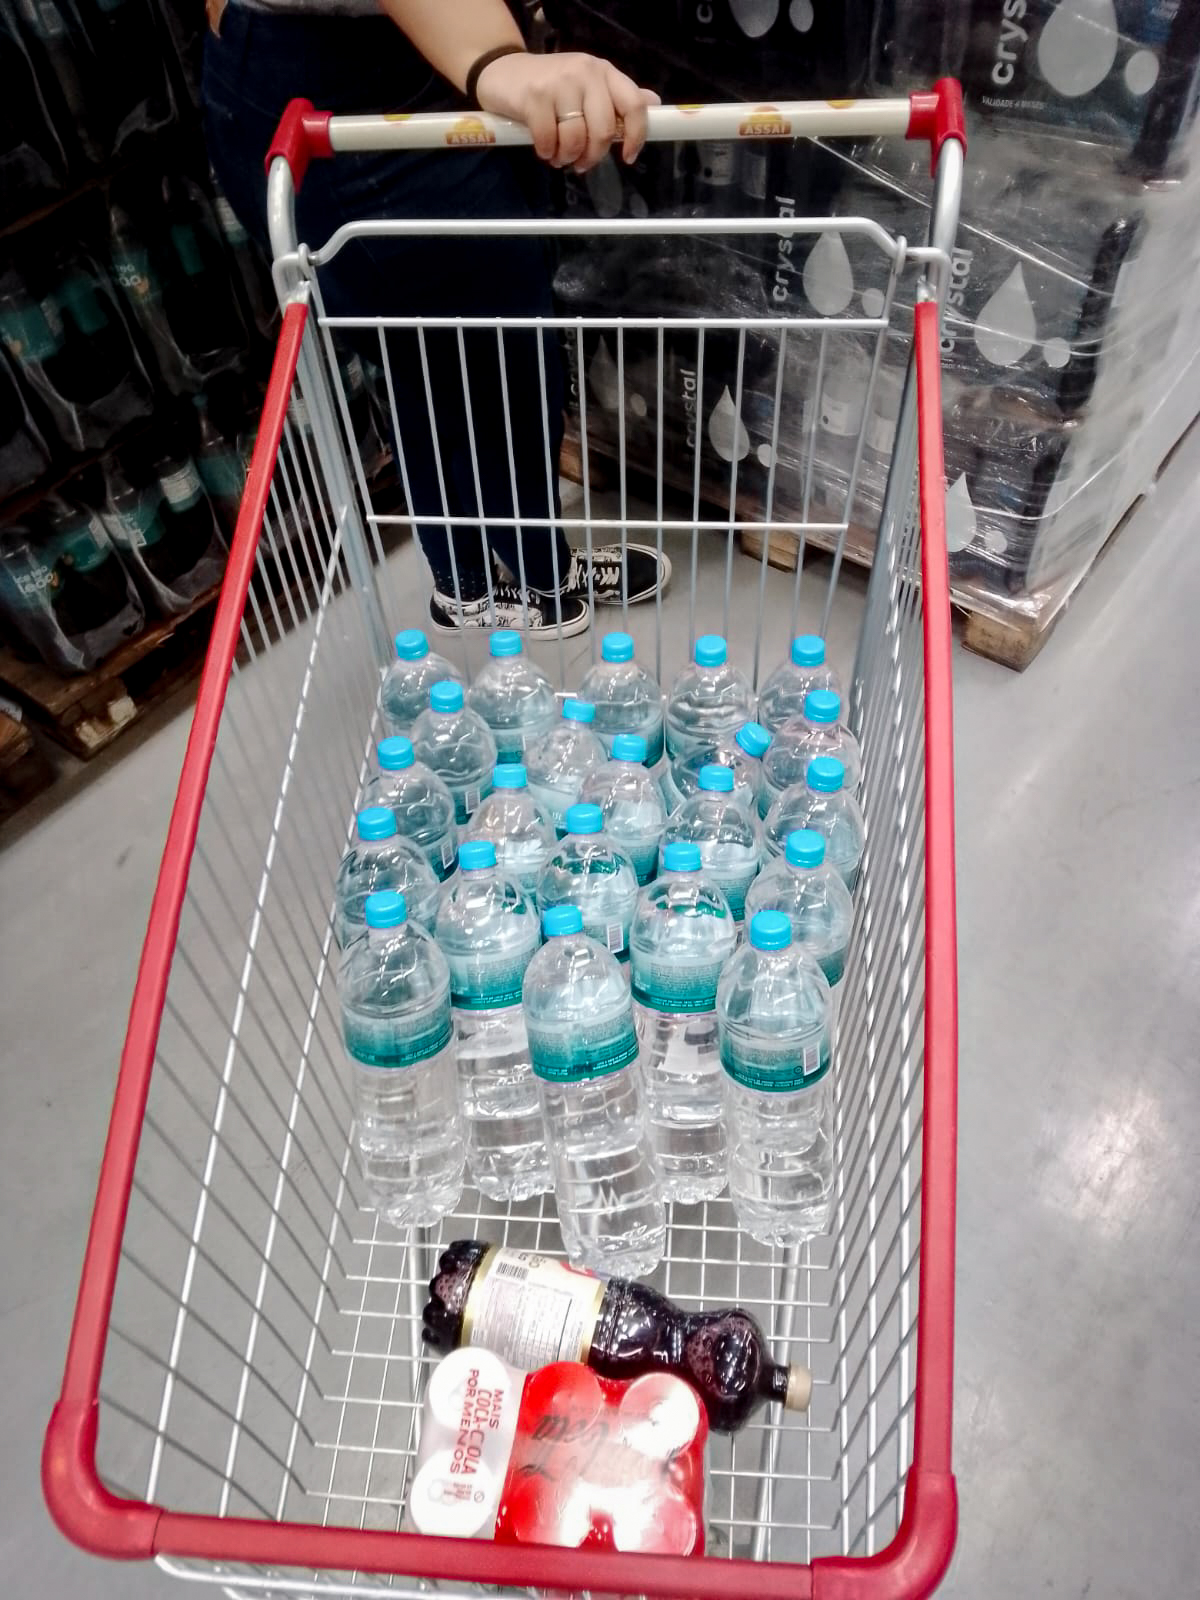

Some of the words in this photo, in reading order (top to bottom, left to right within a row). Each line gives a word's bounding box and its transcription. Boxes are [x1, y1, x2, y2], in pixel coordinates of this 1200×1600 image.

[464, 1368, 480, 1398] POR
[489, 1389, 504, 1430] MAIS
[450, 1400, 475, 1475] MENOS
[461, 1388, 493, 1475] COCA-COLA
